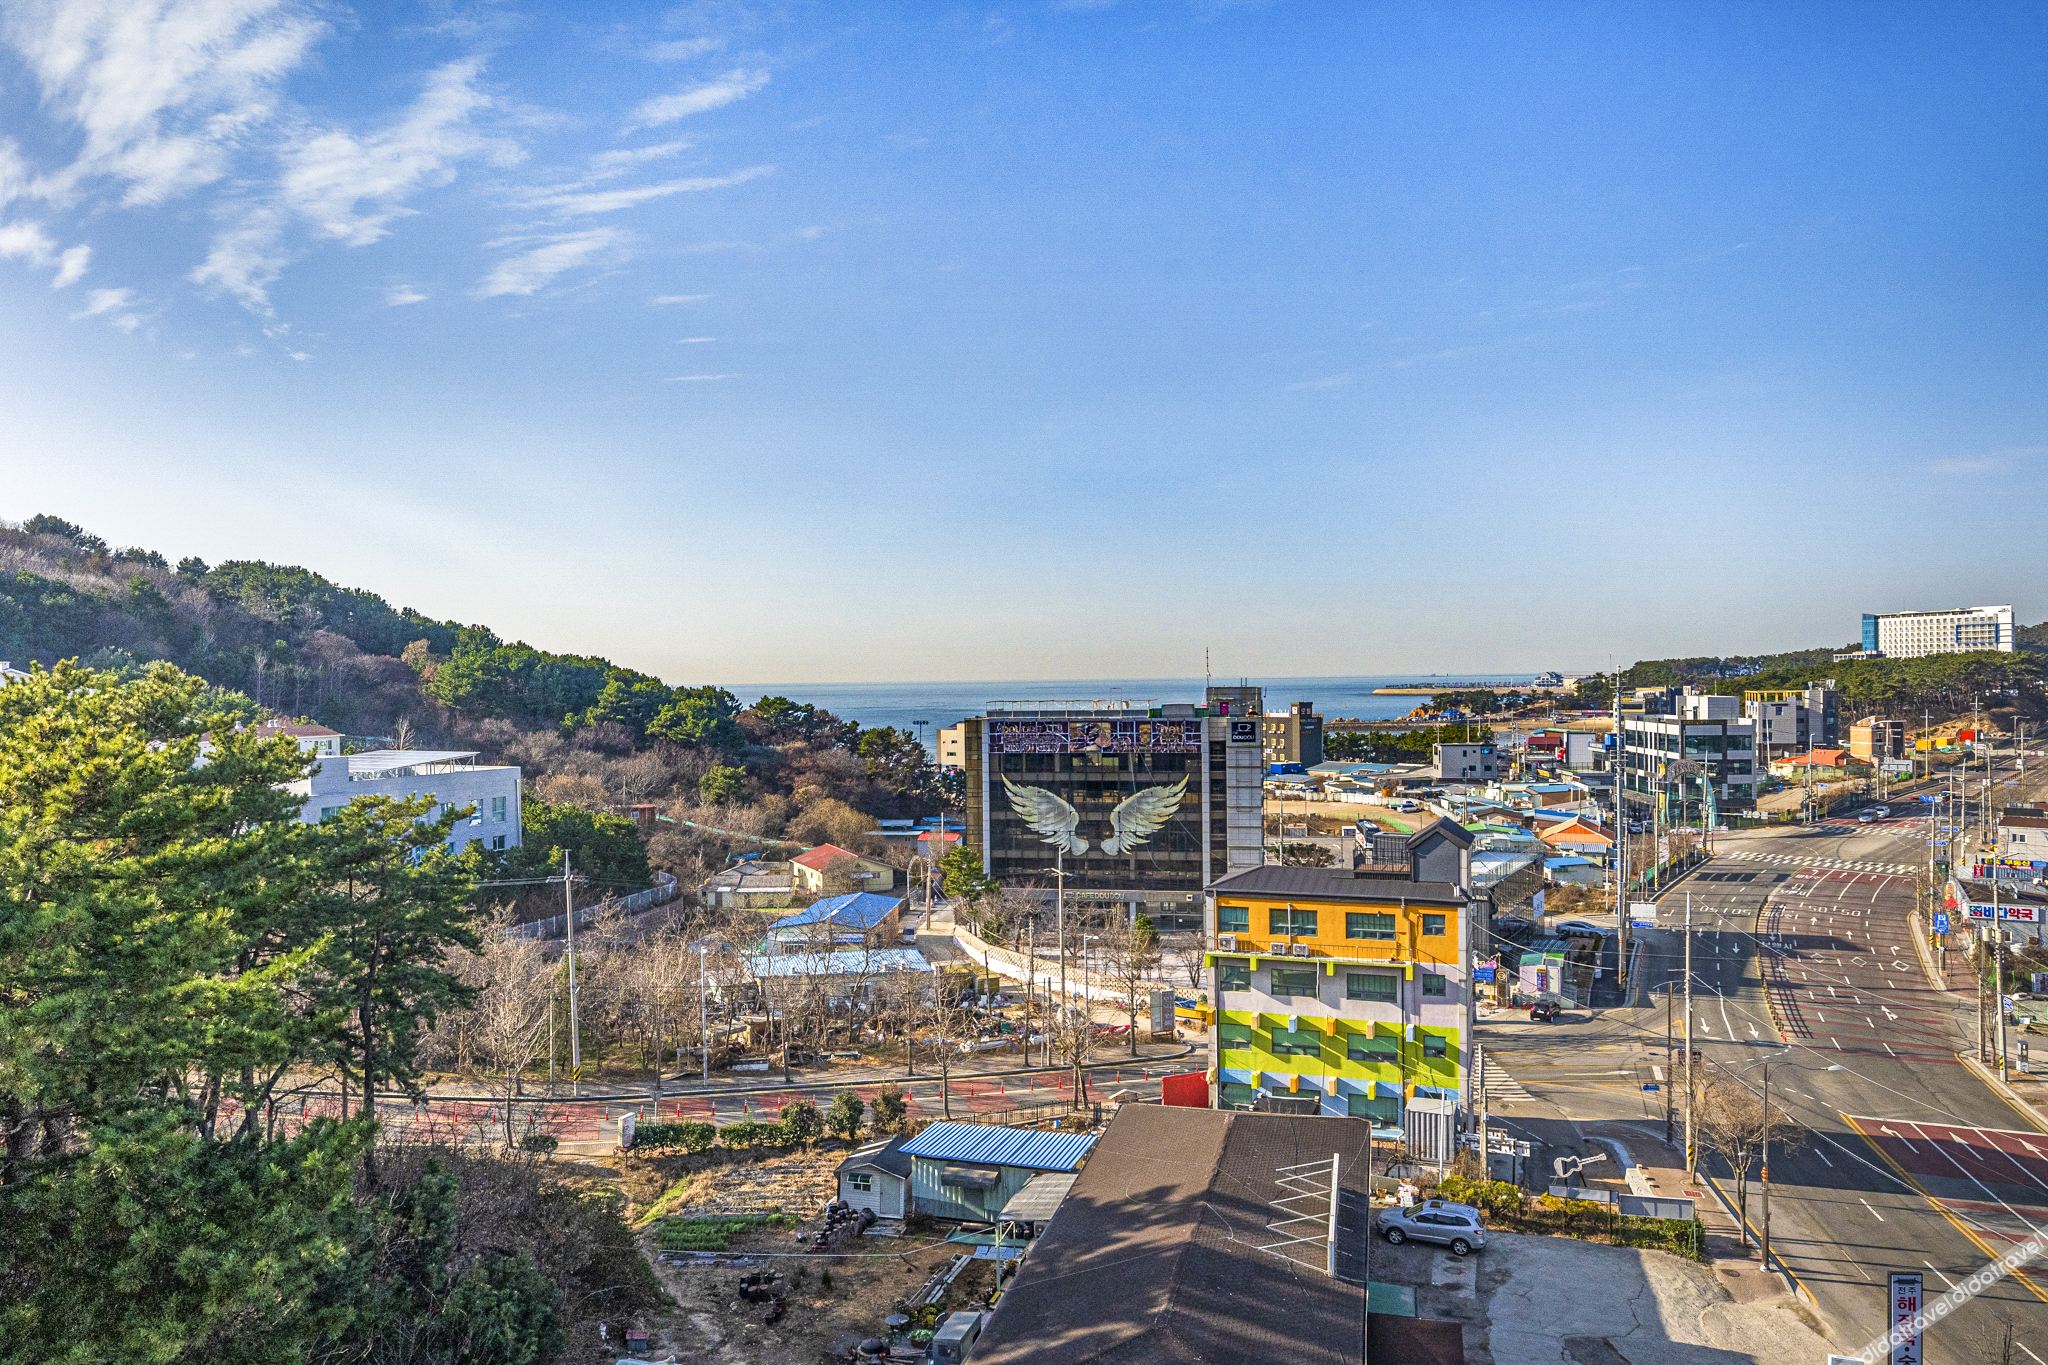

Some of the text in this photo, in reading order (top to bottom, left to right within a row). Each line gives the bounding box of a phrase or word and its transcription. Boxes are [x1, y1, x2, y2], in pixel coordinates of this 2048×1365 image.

[1808, 905, 1861, 917] 50 50
[1898, 1286, 1917, 1295] 전주
